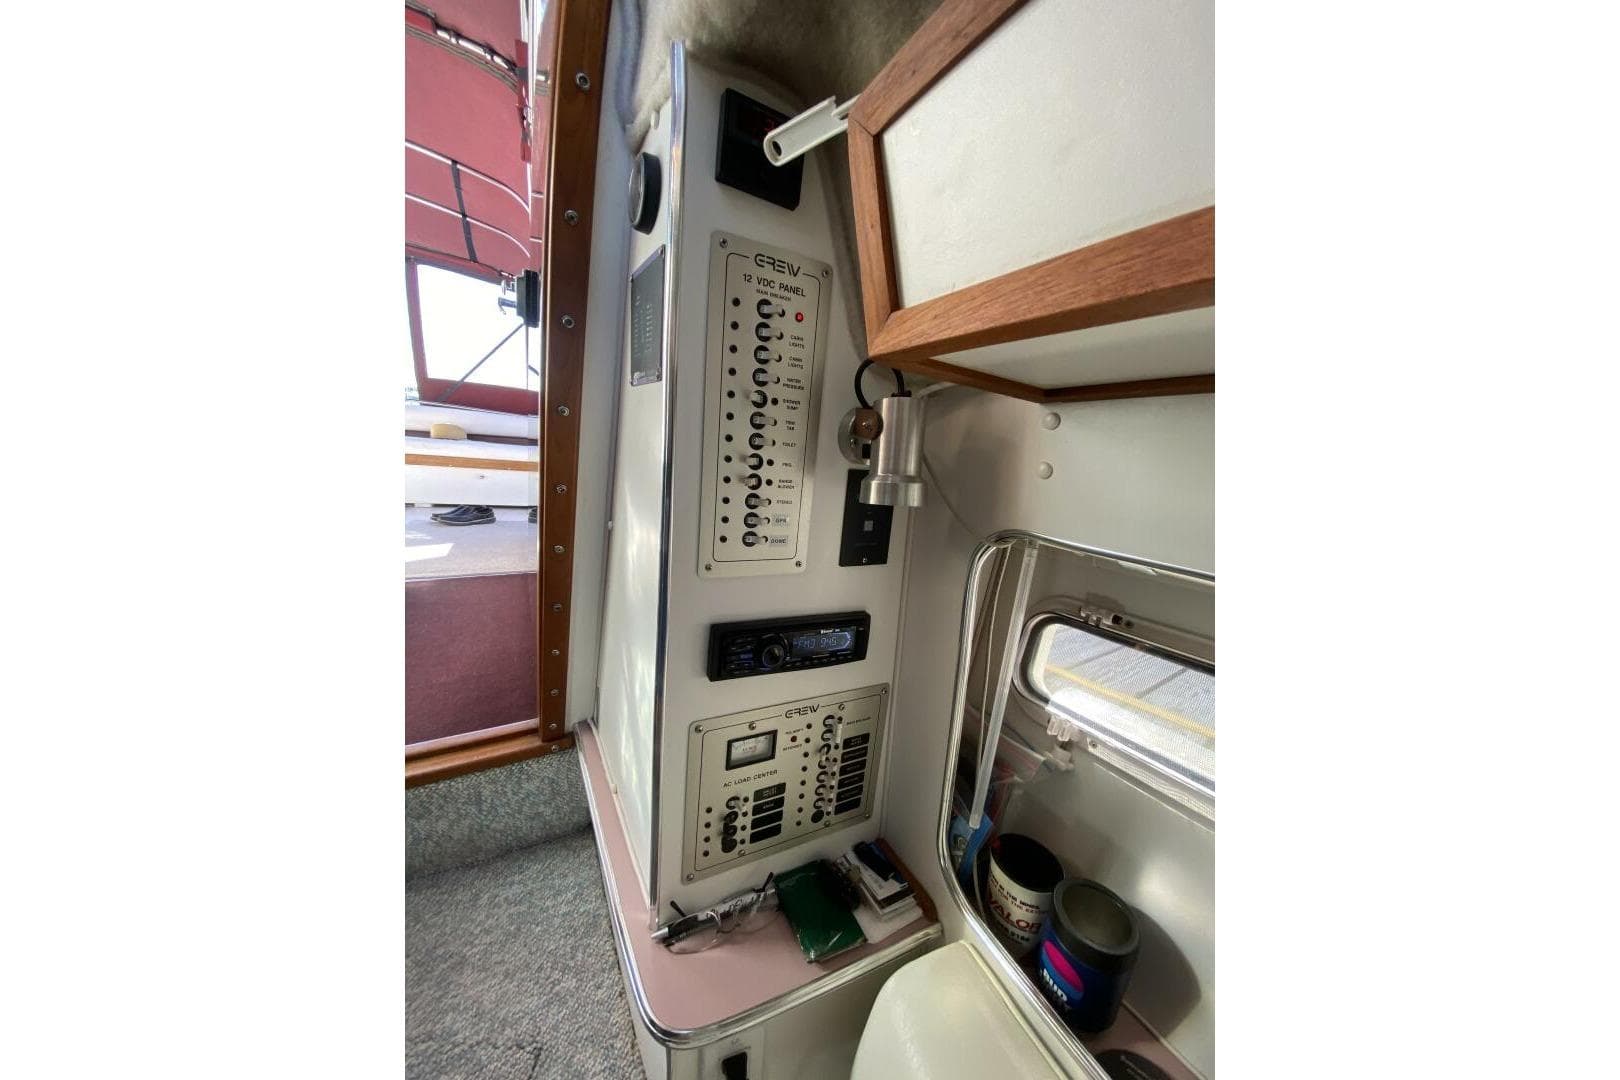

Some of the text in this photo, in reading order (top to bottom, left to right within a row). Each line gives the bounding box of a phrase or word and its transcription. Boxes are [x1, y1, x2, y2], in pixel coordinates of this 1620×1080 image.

[754, 253, 801, 277] GREW
[743, 273, 806, 297] 12 VDC PANEL
[784, 704, 820, 719] GREW
[734, 775, 751, 786] LOAD
[753, 769, 778, 781] CENTER
